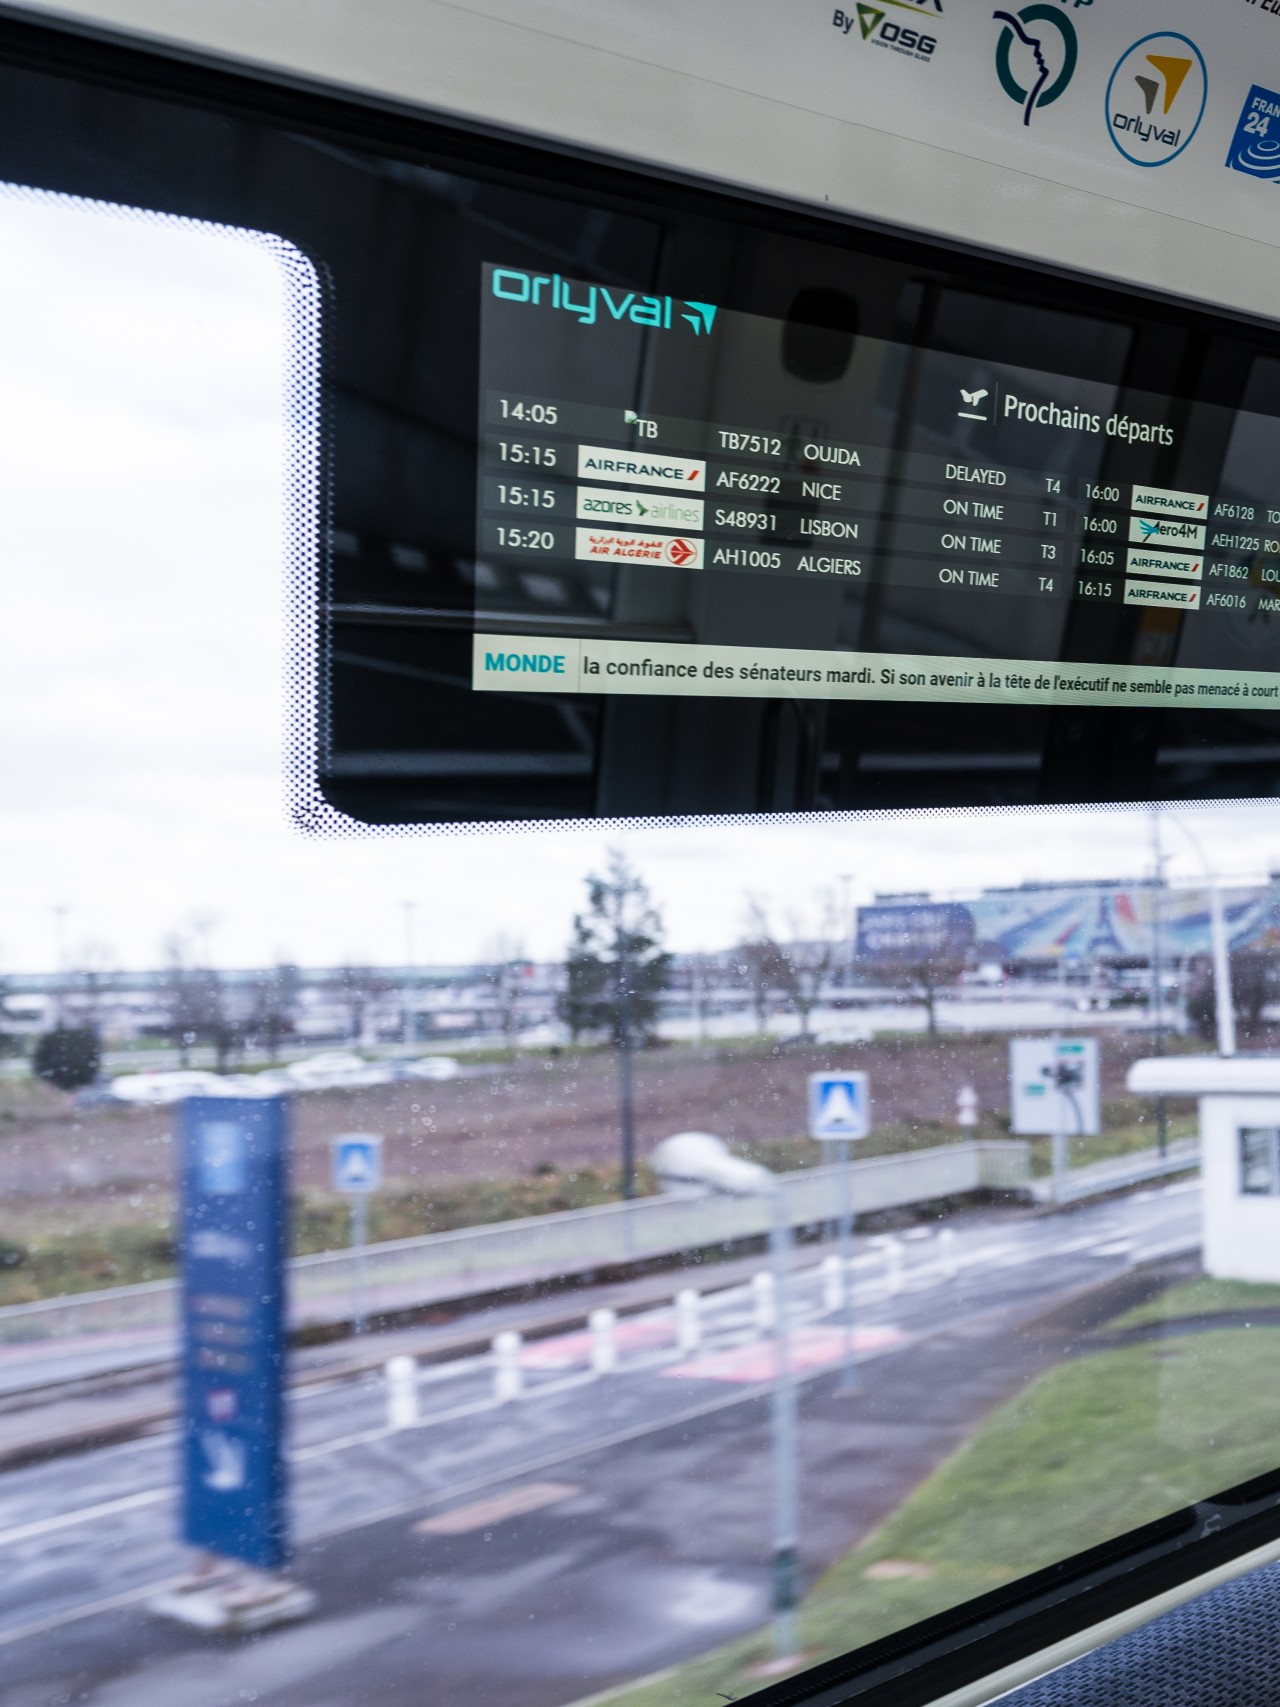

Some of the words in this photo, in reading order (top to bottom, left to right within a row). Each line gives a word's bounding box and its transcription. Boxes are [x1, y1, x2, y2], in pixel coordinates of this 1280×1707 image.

[832, 9, 855, 35] By
[1113, 113, 1181, 147] orlyval
[1243, 111, 1270, 137] 24
[492, 268, 672, 329] orlyval
[1004, 394, 1100, 433] Prochains
[1106, 413, 1174, 445] départs
[499, 399, 558, 425] 14:05
[637, 419, 659, 439] TB
[719, 431, 781, 456] TB7512
[804, 444, 861, 467] OUJDA
[945, 464, 1007, 486] DELAYED
[1045, 478, 1061, 494] T4
[498, 442, 556, 467] 15:15
[584, 458, 684, 480] AIRFRANCE
[716, 472, 781, 494] AF6222
[802, 482, 842, 501] NICE
[943, 499, 968, 516] ON
[972, 502, 1004, 520] TIME
[1043, 511, 1057, 527] T1
[1085, 483, 1120, 502] 16:00
[1135, 494, 1196, 511] AIRFRANCE
[1214, 503, 1255, 521] AF6128
[498, 485, 555, 509] 15:15
[583, 499, 633, 515] azores
[650, 503, 699, 523] airlines
[714, 509, 777, 531] S48931
[800, 518, 858, 540] LISBON
[941, 534, 966, 550] ON
[970, 536, 1002, 554] TIME
[1041, 544, 1056, 560] T3
[1083, 516, 1117, 534] 16:00
[1211, 534, 1260, 551] AEH1225
[497, 528, 554, 551] 15:20
[713, 548, 781, 569] AH1005
[798, 557, 861, 577] ALGIERS
[939, 568, 964, 584] ON
[967, 570, 1000, 588] TIME
[1038, 577, 1054, 592] T4
[590, 546, 610, 554] AIR
[1080, 548, 1115, 566] 16:05
[1130, 557, 1191, 572] AIRFRANCE
[1208, 564, 1249, 580] AF1862
[1078, 580, 1112, 597] 16:15
[1127, 588, 1188, 602] AIRFRANCE
[1206, 594, 1247, 609] AF6016
[485, 652, 565, 673] MONDE
[583, 656, 600, 674] la
[606, 659, 697, 678] confiance
[703, 661, 734, 679] des
[739, 663, 821, 682] sénateurs
[826, 667, 875, 684] mardi.
[880, 668, 895, 684] Si
[899, 673, 925, 685] son
[930, 672, 974, 687] avenir
[977, 672, 985, 687] à
[989, 673, 1000, 688] la
[1005, 674, 1031, 689] tête
[1034, 675, 1050, 690] de
[1054, 675, 1110, 692] l'exécutif
[1112, 681, 1127, 692] ne
[1129, 680, 1172, 694] semble
[1174, 683, 1195, 697] pas
[1198, 683, 1240, 696] menacé
[1242, 683, 1249, 697] à
[1251, 685, 1278, 698] court
